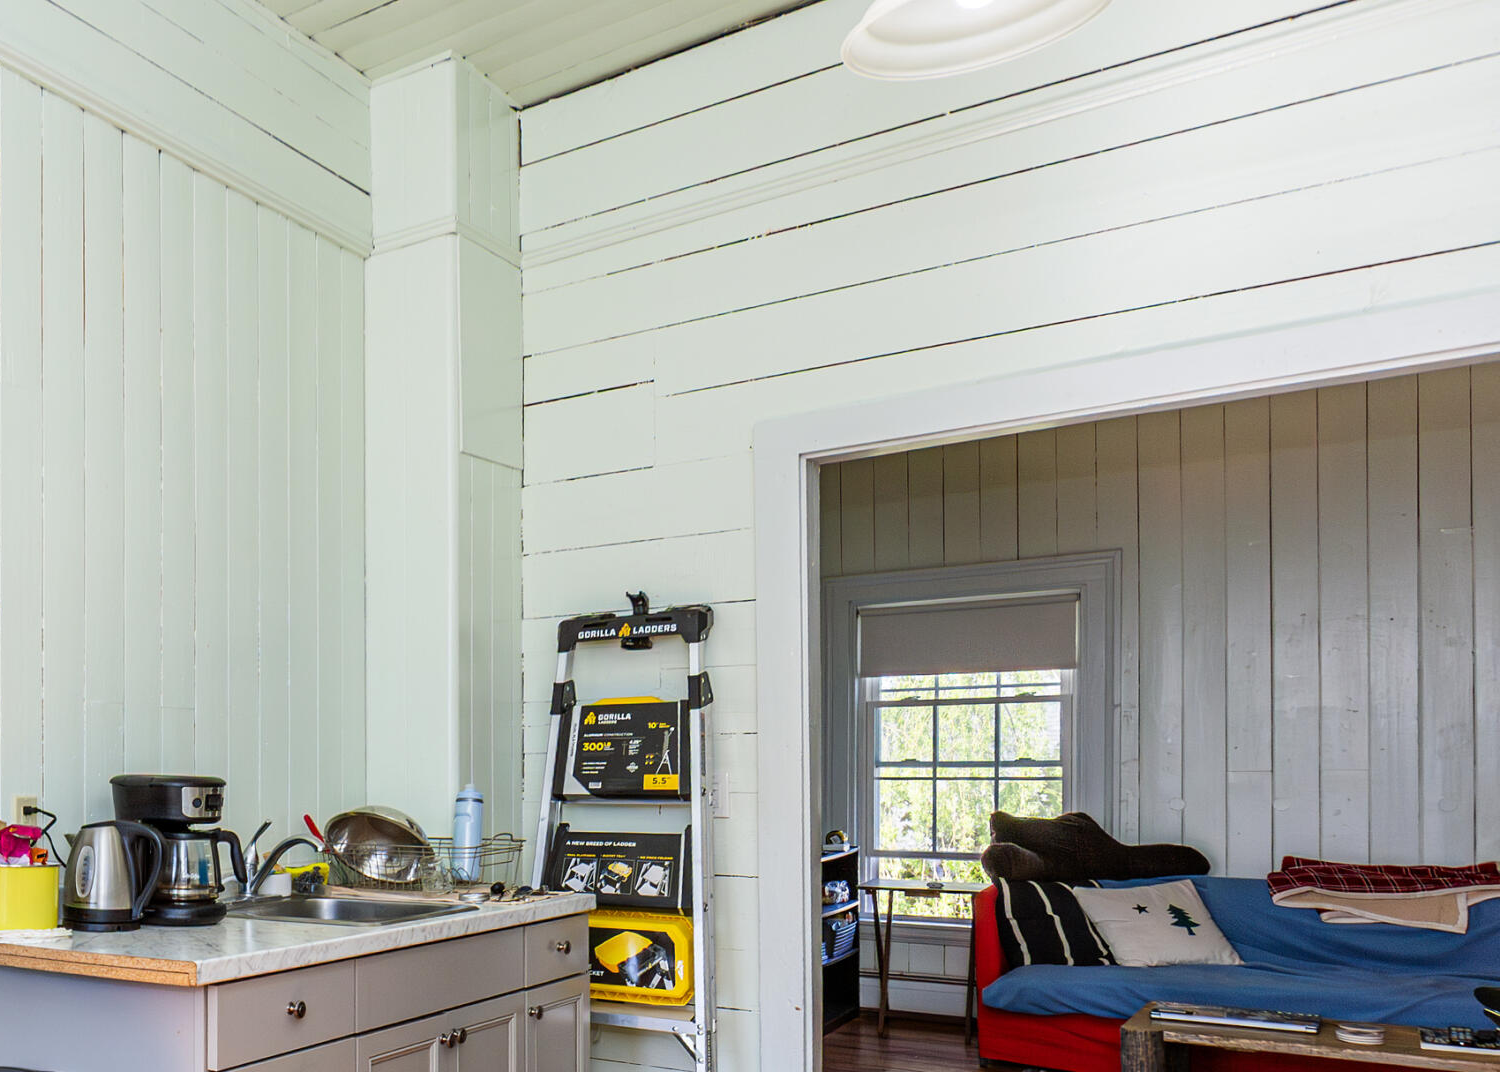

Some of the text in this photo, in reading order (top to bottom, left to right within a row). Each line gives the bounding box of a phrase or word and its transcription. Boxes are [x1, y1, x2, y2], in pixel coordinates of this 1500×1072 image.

[578, 624, 677, 639] GORILLA LADDERS
[583, 742, 604, 751] 300
